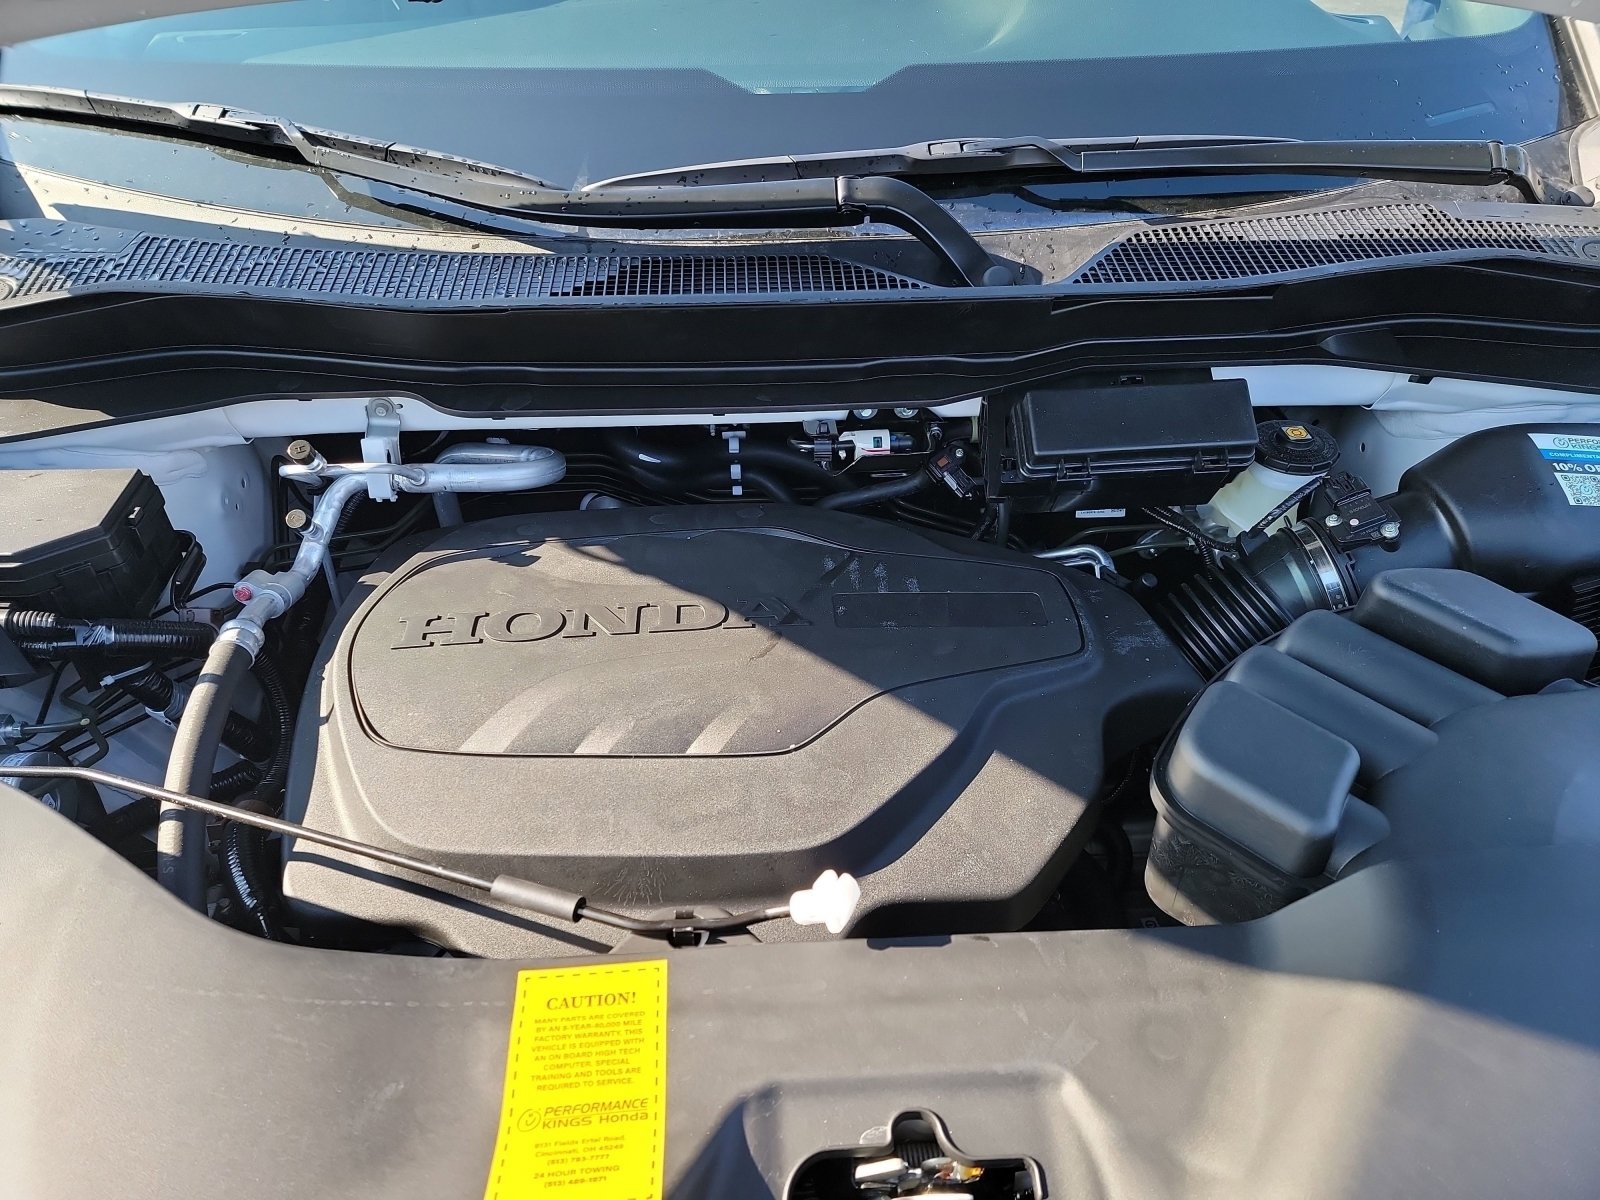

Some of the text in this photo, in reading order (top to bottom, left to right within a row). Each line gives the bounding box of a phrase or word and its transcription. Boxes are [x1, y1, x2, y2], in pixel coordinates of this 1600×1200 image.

[1552, 462, 1583, 472] 10%
[390, 600, 816, 651] HONDA
[546, 991, 636, 1011] CAUTION!
[606, 1010, 646, 1020] COVERED
[535, 1026, 547, 1034] BY
[534, 1034, 573, 1042] FACTORY
[531, 1044, 567, 1053] VEHICLE
[579, 1039, 621, 1049] EQUIPPED
[623, 1037, 645, 1045] WITH
[563, 1051, 593, 1060] BOARD
[595, 1049, 617, 1057] HIGH
[618, 1047, 641, 1055] TECH
[595, 1057, 630, 1066] SPECIAL
[531, 1066, 641, 1082] TRAINING AND TOOLS ARE
[536, 1081, 581, 1092] REQUIRED
[583, 1080, 594, 1088] TO
[544, 1097, 649, 1117] PERFORMANCE
[542, 1111, 649, 1130] KINGS Honda
[547, 1168, 577, 1178] HOUR
[580, 1164, 620, 1174] TOWING
